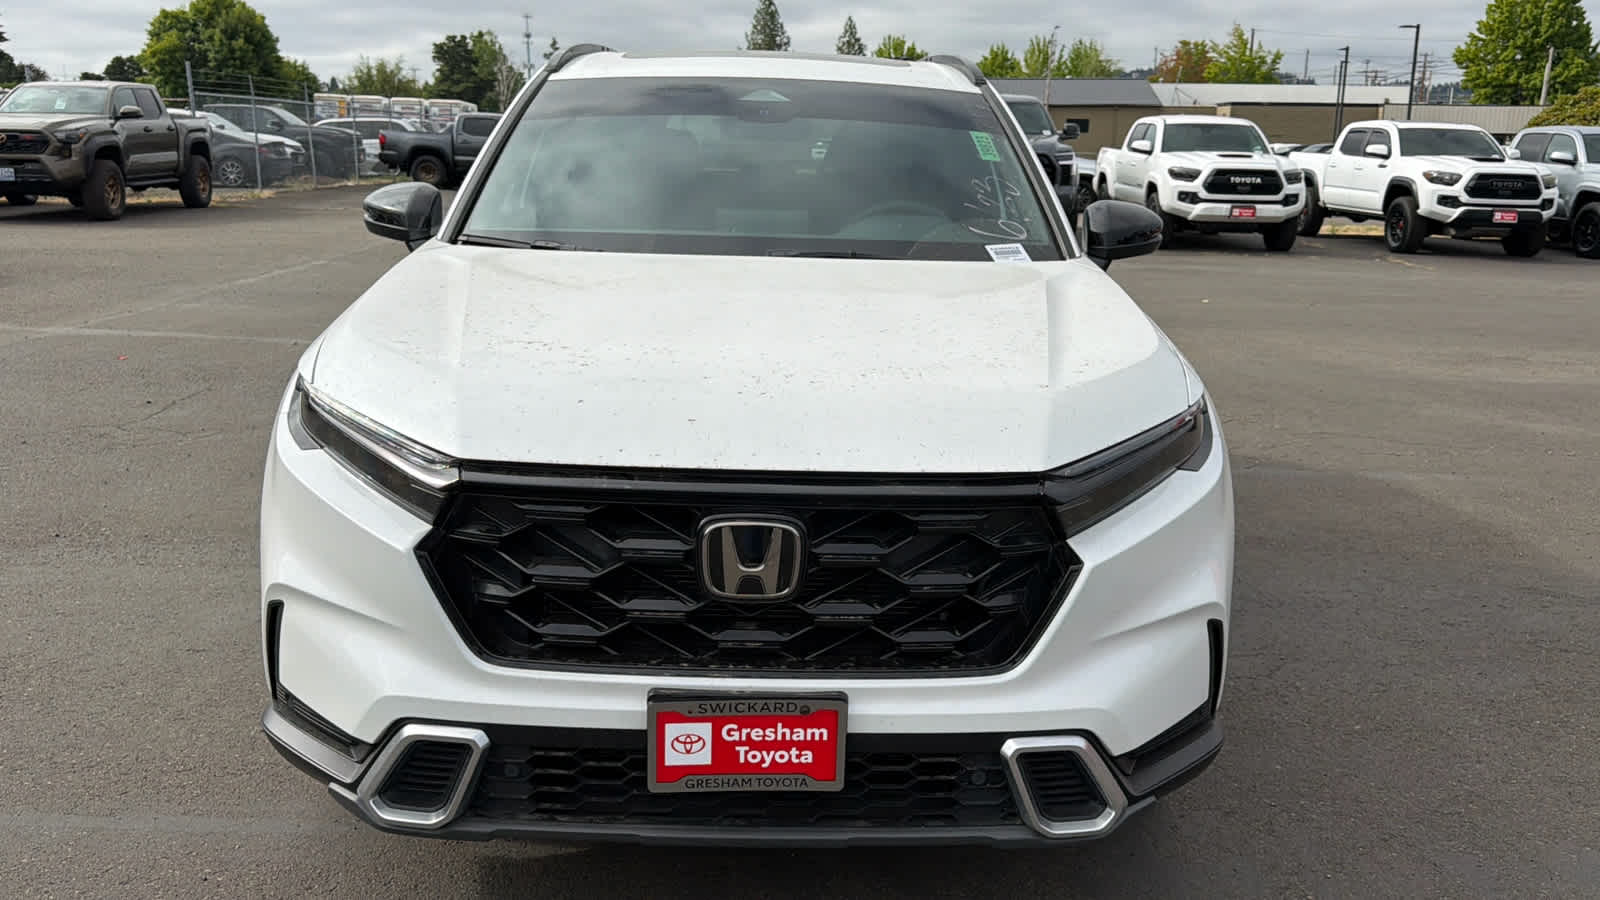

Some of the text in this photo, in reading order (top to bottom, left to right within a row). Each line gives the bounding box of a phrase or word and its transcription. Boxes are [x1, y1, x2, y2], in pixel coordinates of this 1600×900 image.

[1230, 176, 1262, 184] TOYOTA
[697, 702, 798, 714] SWICKARD
[721, 722, 828, 742] Gresham
[735, 746, 813, 768] Toyota
[684, 777, 809, 789] GRESHAM TOYOTA
